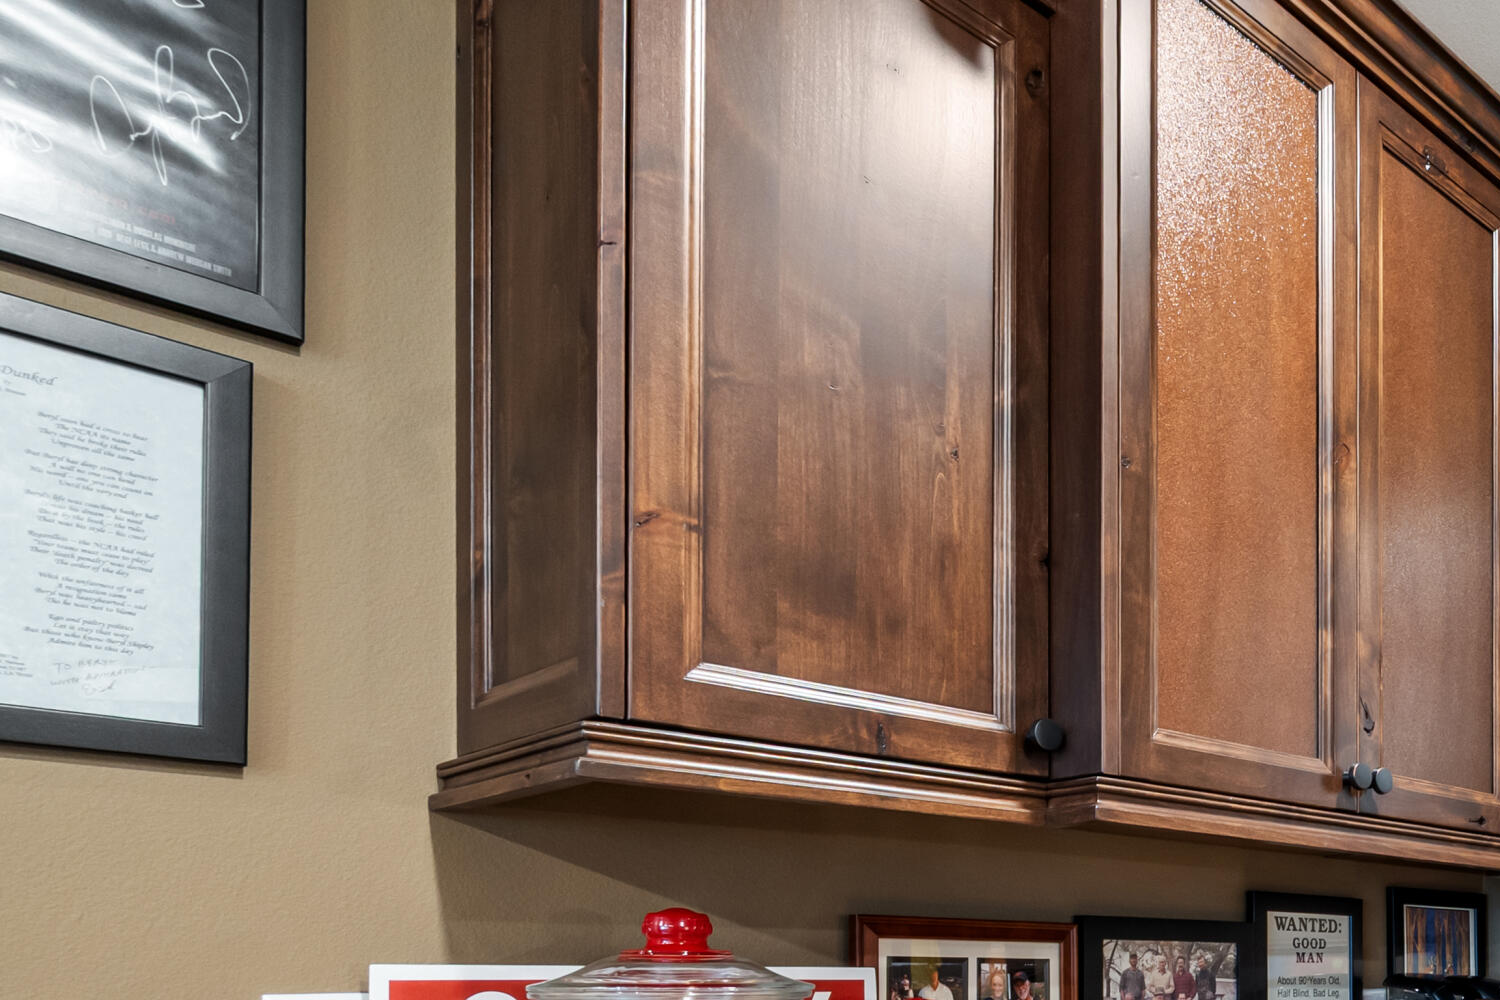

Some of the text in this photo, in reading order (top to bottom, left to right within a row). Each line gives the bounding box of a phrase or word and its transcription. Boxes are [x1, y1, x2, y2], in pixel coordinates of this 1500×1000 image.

[1274, 916, 1342, 934] WANTED:
[1292, 937, 1326, 950] GOOD
[1296, 952, 1324, 963] MAN
[1277, 976, 1296, 985] About
[1277, 989, 1291, 998] Half
[1313, 989, 1326, 998] Bad
